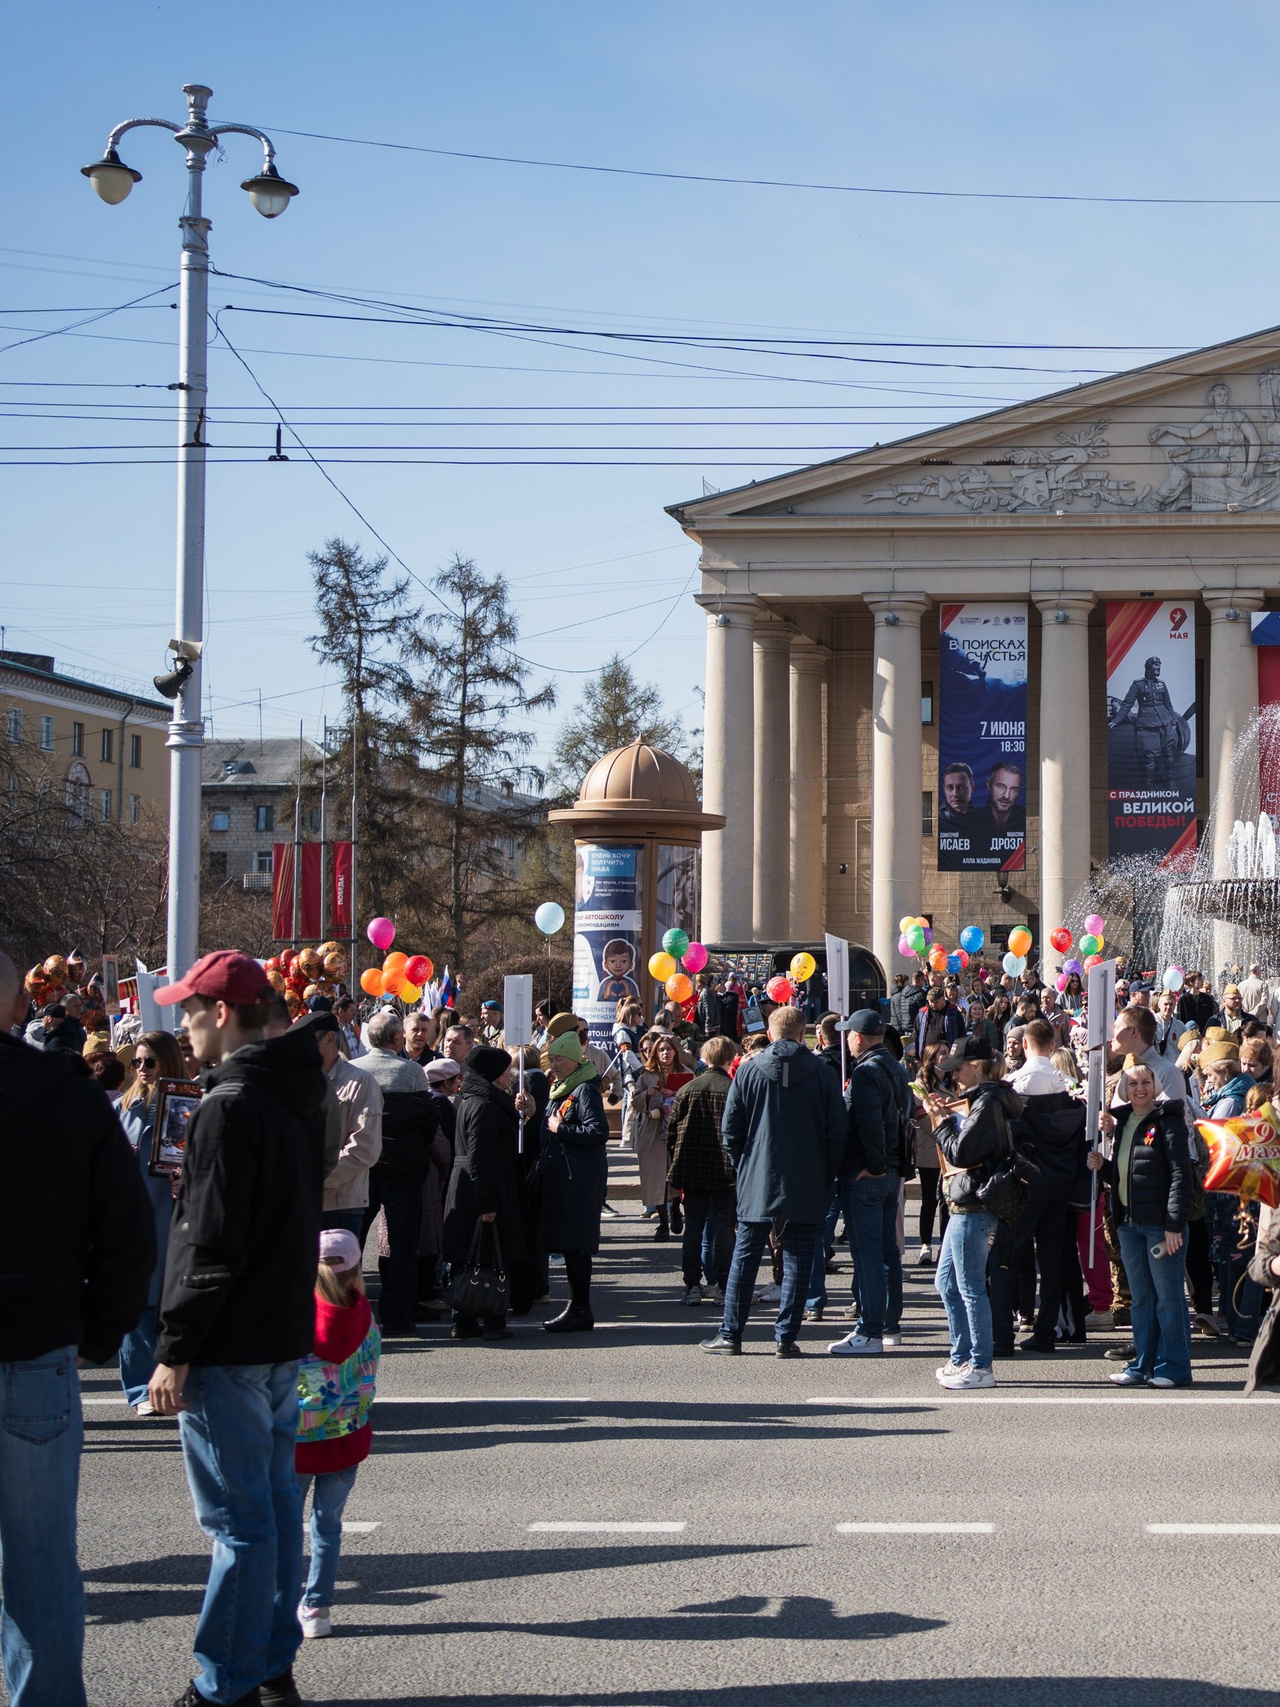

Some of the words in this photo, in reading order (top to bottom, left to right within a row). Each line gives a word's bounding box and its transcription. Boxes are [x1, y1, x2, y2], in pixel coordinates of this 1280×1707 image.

[1169, 607, 1188, 631] 9
[1169, 632, 1188, 640] МАЯ
[949, 640, 959, 650] В
[962, 639, 1026, 650] ПОИСКАХ
[965, 651, 1026, 662] СЧАСТЬЯ
[980, 721, 988, 736] 7
[990, 721, 1025, 736] ИЮНЯ
[1000, 740, 1025, 752] 18:30
[1109, 791, 1117, 799] С
[1118, 790, 1180, 799] ПРАЗДНИКОМ
[1123, 797, 1195, 814] ВЕЛИКОЙ
[1114, 815, 1186, 829] ПОБЕДЫ!
[940, 838, 971, 851] ИСАЕВ
[337, 874, 345, 905] ПОБЕДА!
[1250, 1122, 1276, 1145] 9
